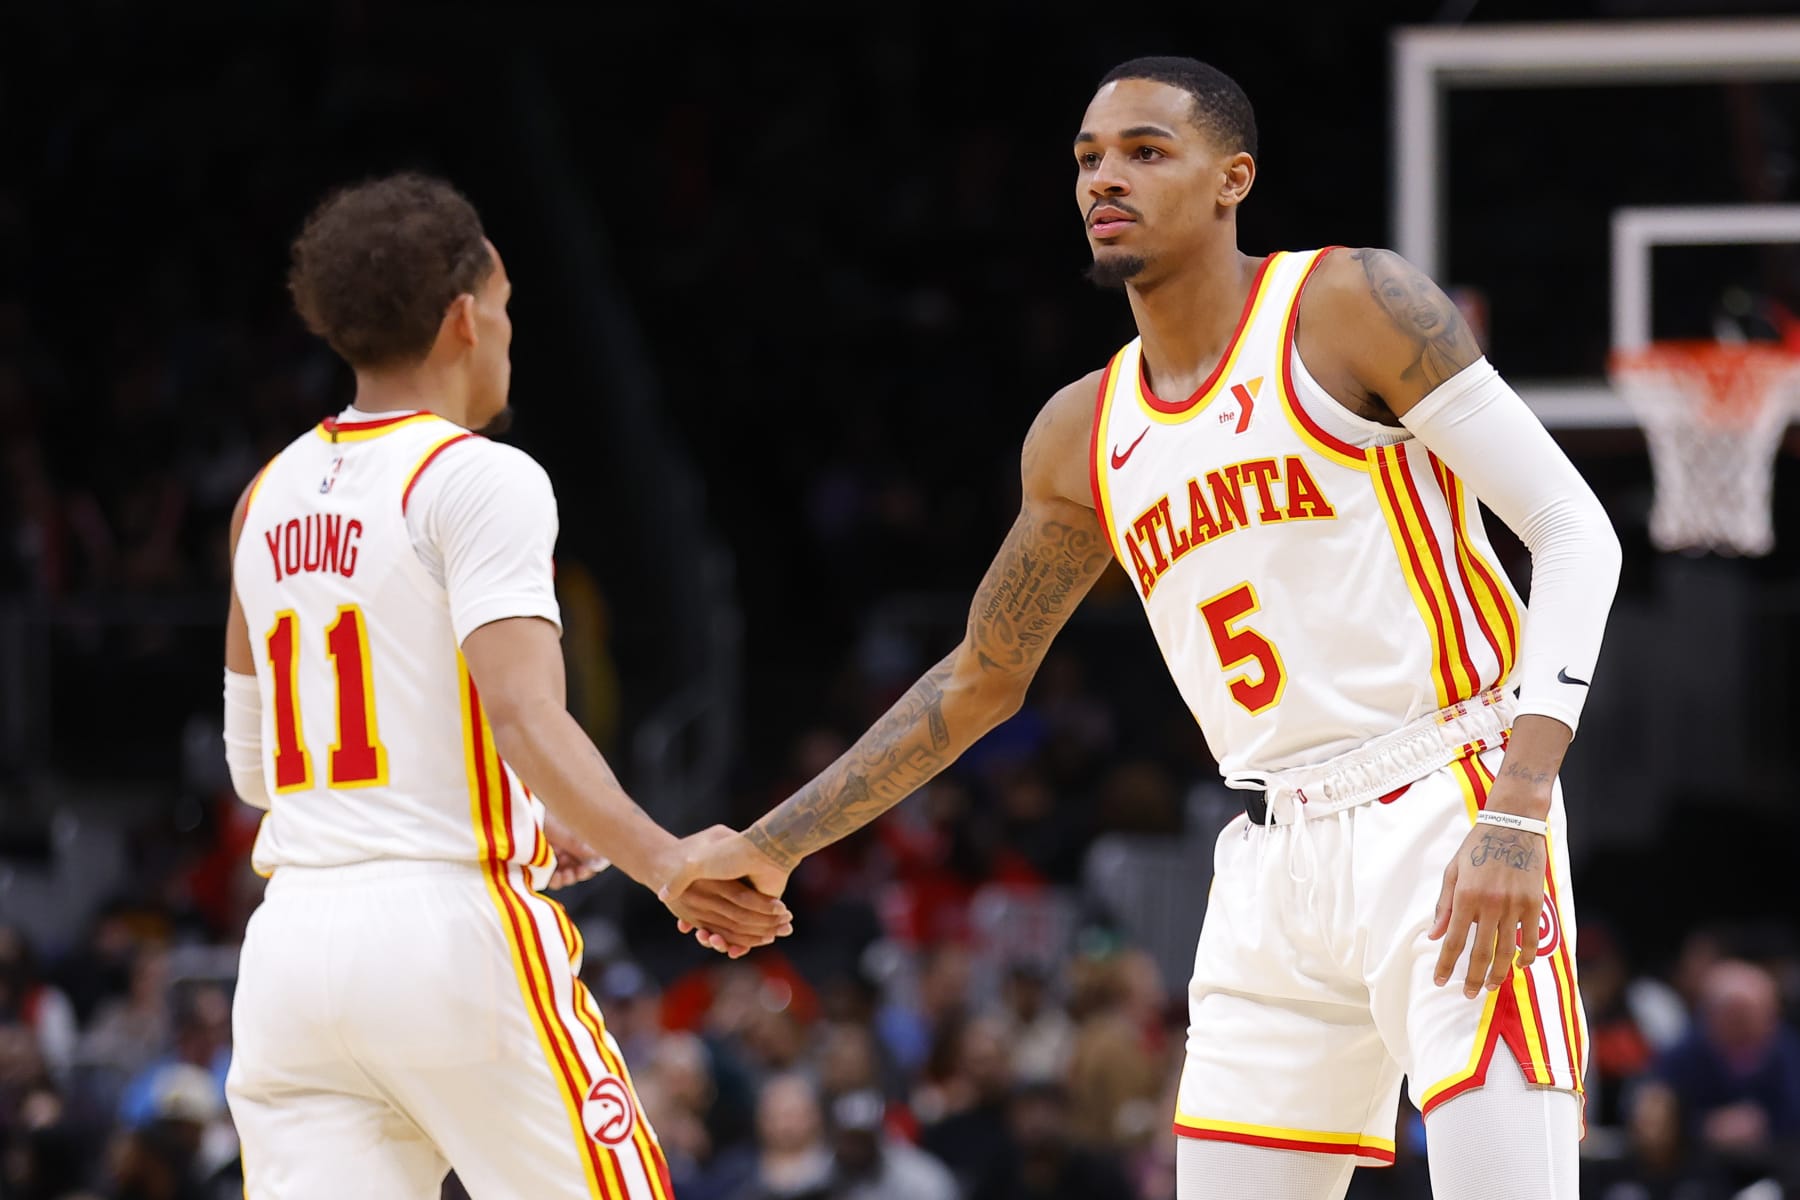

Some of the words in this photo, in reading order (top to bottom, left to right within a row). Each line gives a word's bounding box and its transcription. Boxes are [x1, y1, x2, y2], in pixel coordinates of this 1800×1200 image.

[1218, 410, 1235, 424] the
[265, 513, 363, 583] YOUNG
[1124, 455, 1338, 603] ATLANTA
[265, 602, 390, 795] 11
[1196, 580, 1289, 717] 5
[1471, 832, 1534, 872] First
